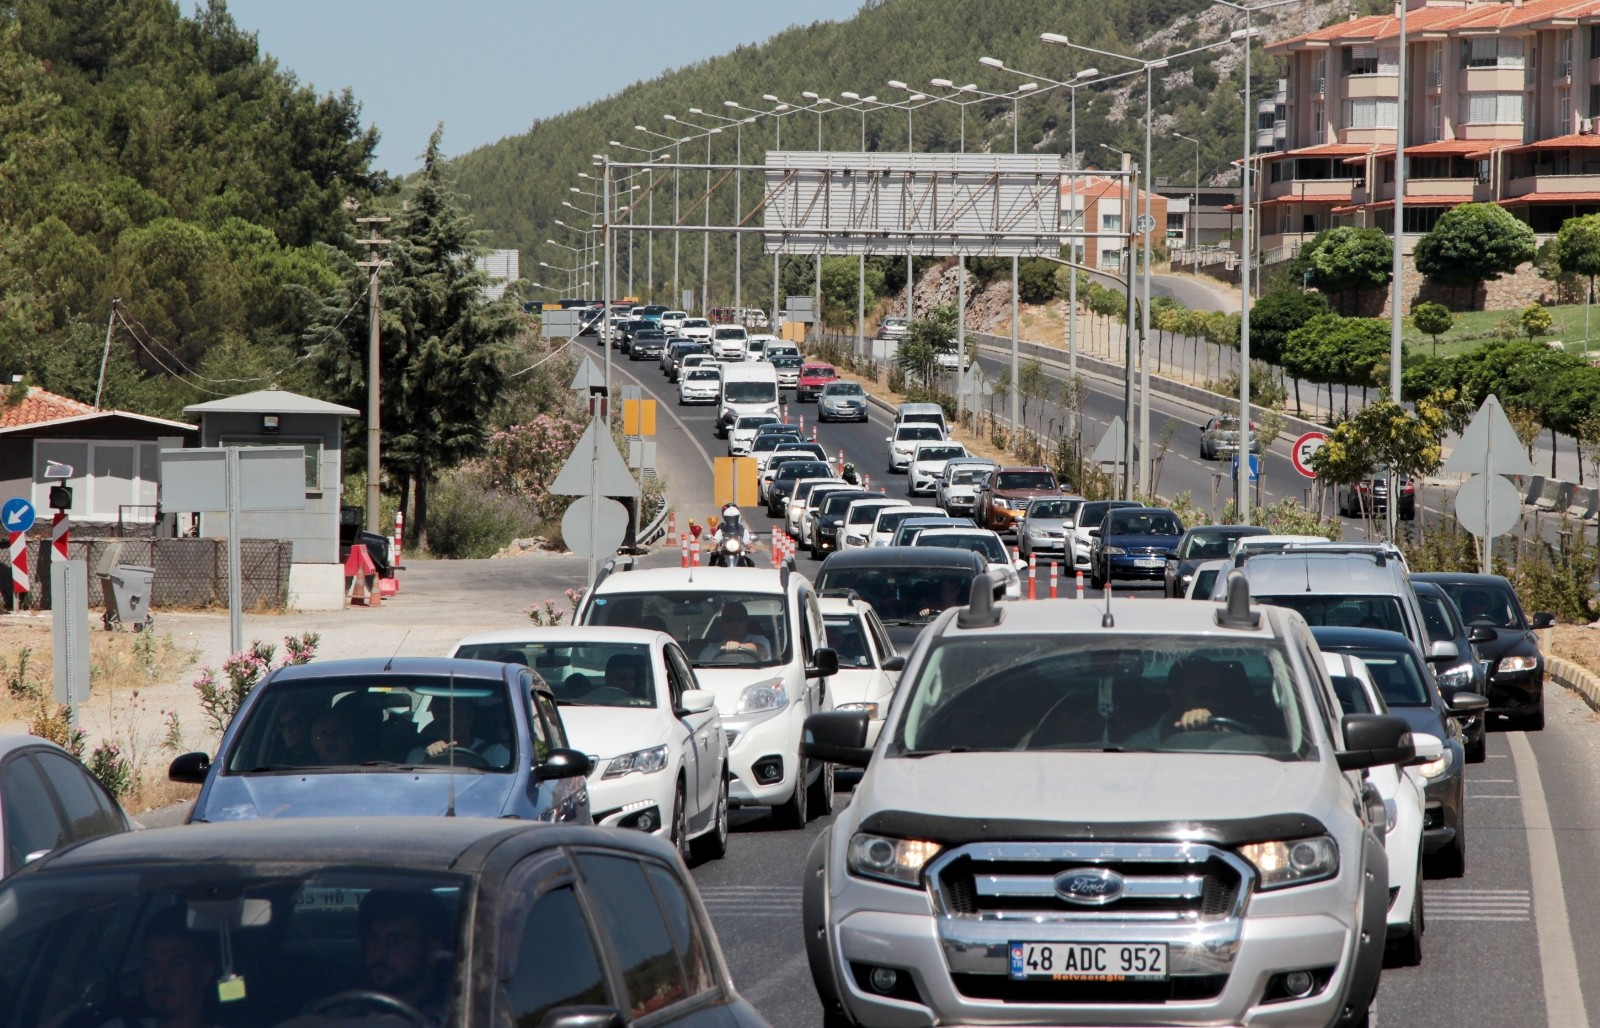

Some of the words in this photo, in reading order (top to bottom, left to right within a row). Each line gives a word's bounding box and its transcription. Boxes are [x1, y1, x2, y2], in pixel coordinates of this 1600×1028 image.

[1070, 877, 1106, 892] Ford
[1026, 947, 1053, 971] 48
[1065, 947, 1106, 971] ADC
[1120, 947, 1161, 971] 952
